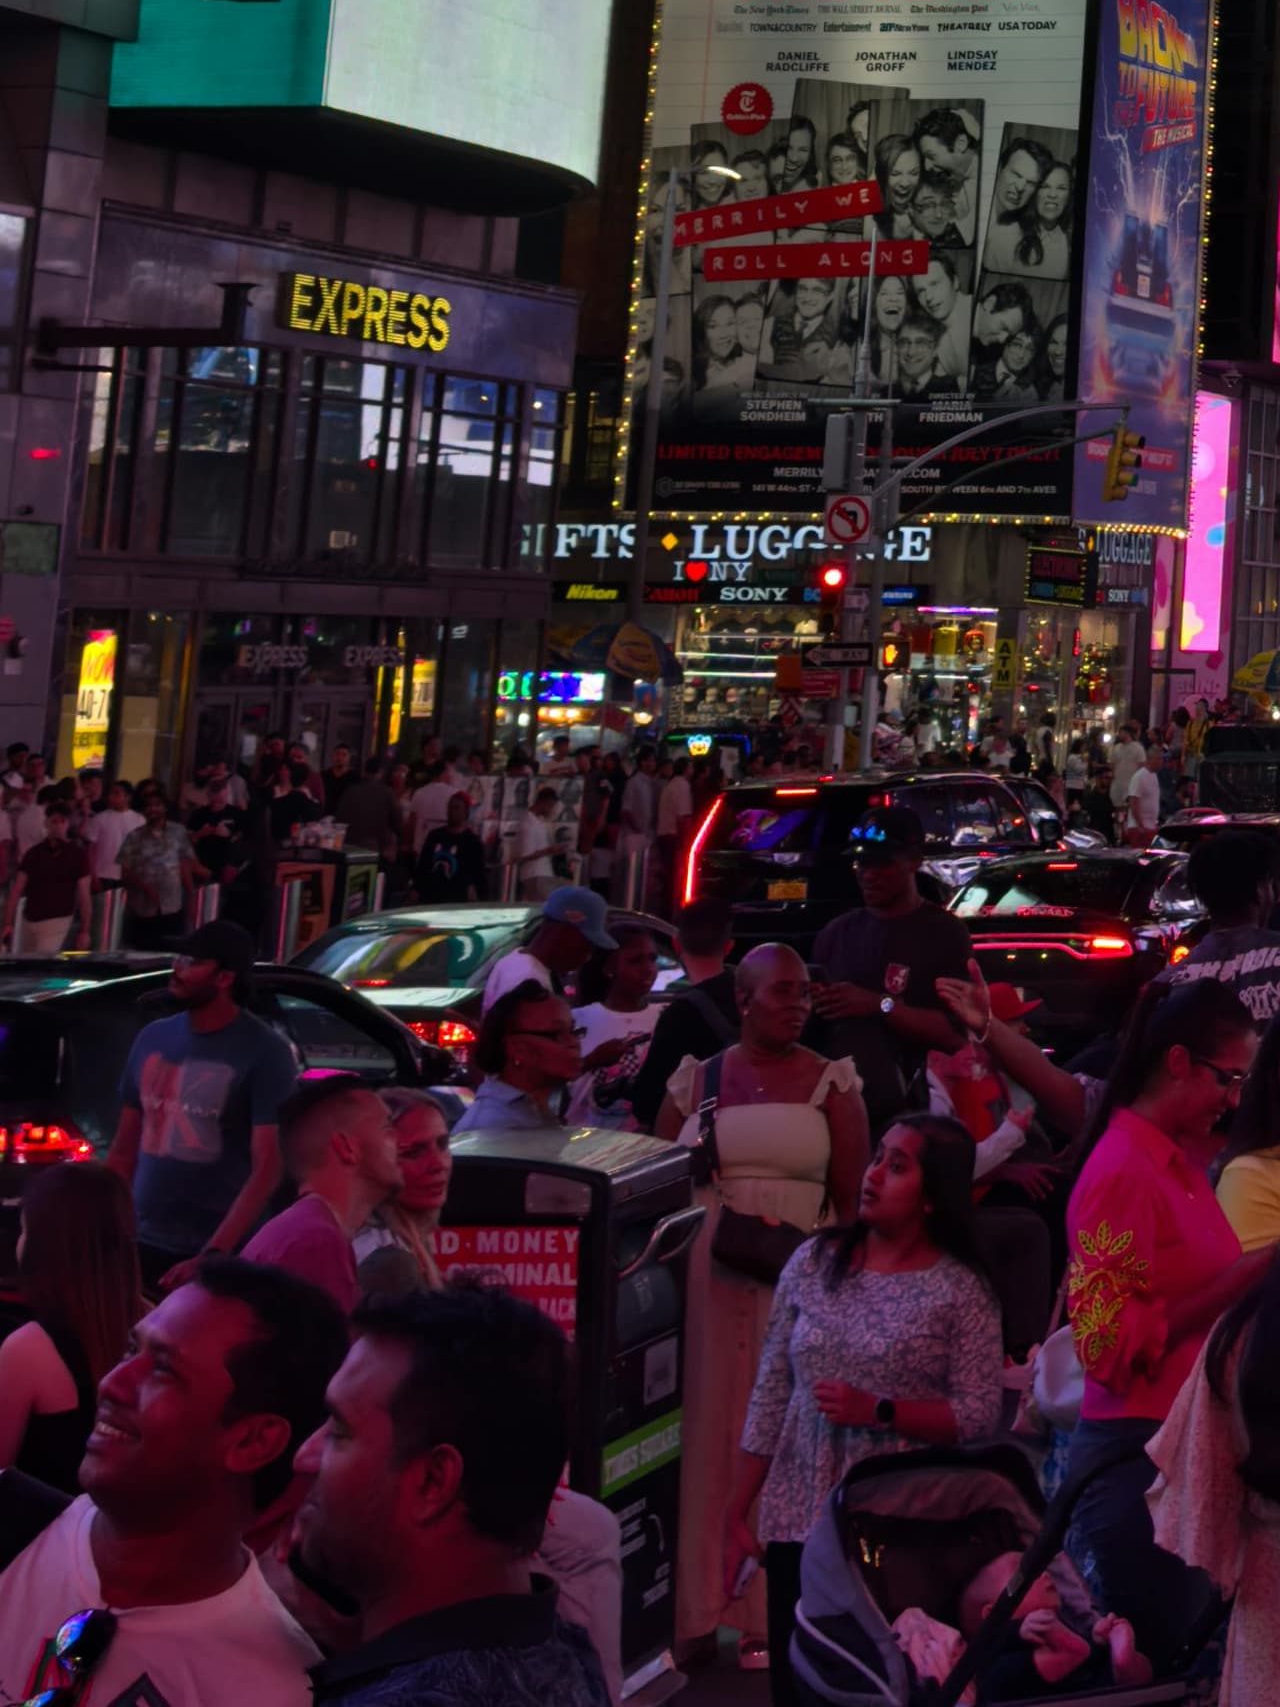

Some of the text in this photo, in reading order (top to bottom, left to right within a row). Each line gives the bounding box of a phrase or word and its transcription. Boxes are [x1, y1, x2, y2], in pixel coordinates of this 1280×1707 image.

[998, 21, 1057, 31] USA TODAY
[777, 51, 820, 61] DANIEL
[855, 51, 917, 62] JONATHAN
[947, 50, 999, 61] LINDSAY
[766, 62, 830, 73] RADCLIFFE
[866, 61, 906, 72] GROFF
[947, 61, 997, 72] MENDEZ
[835, 187, 870, 207] WE
[711, 255, 787, 272] ROLL
[288, 272, 452, 353] EXPRESS
[919, 412, 984, 423] FRIEDMAN
[707, 561, 752, 582] NY
[565, 583, 619, 601] Nikon
[719, 586, 789, 603] SONY
[1109, 589, 1129, 603] SONY
[476, 1229, 580, 1255] MONEY
